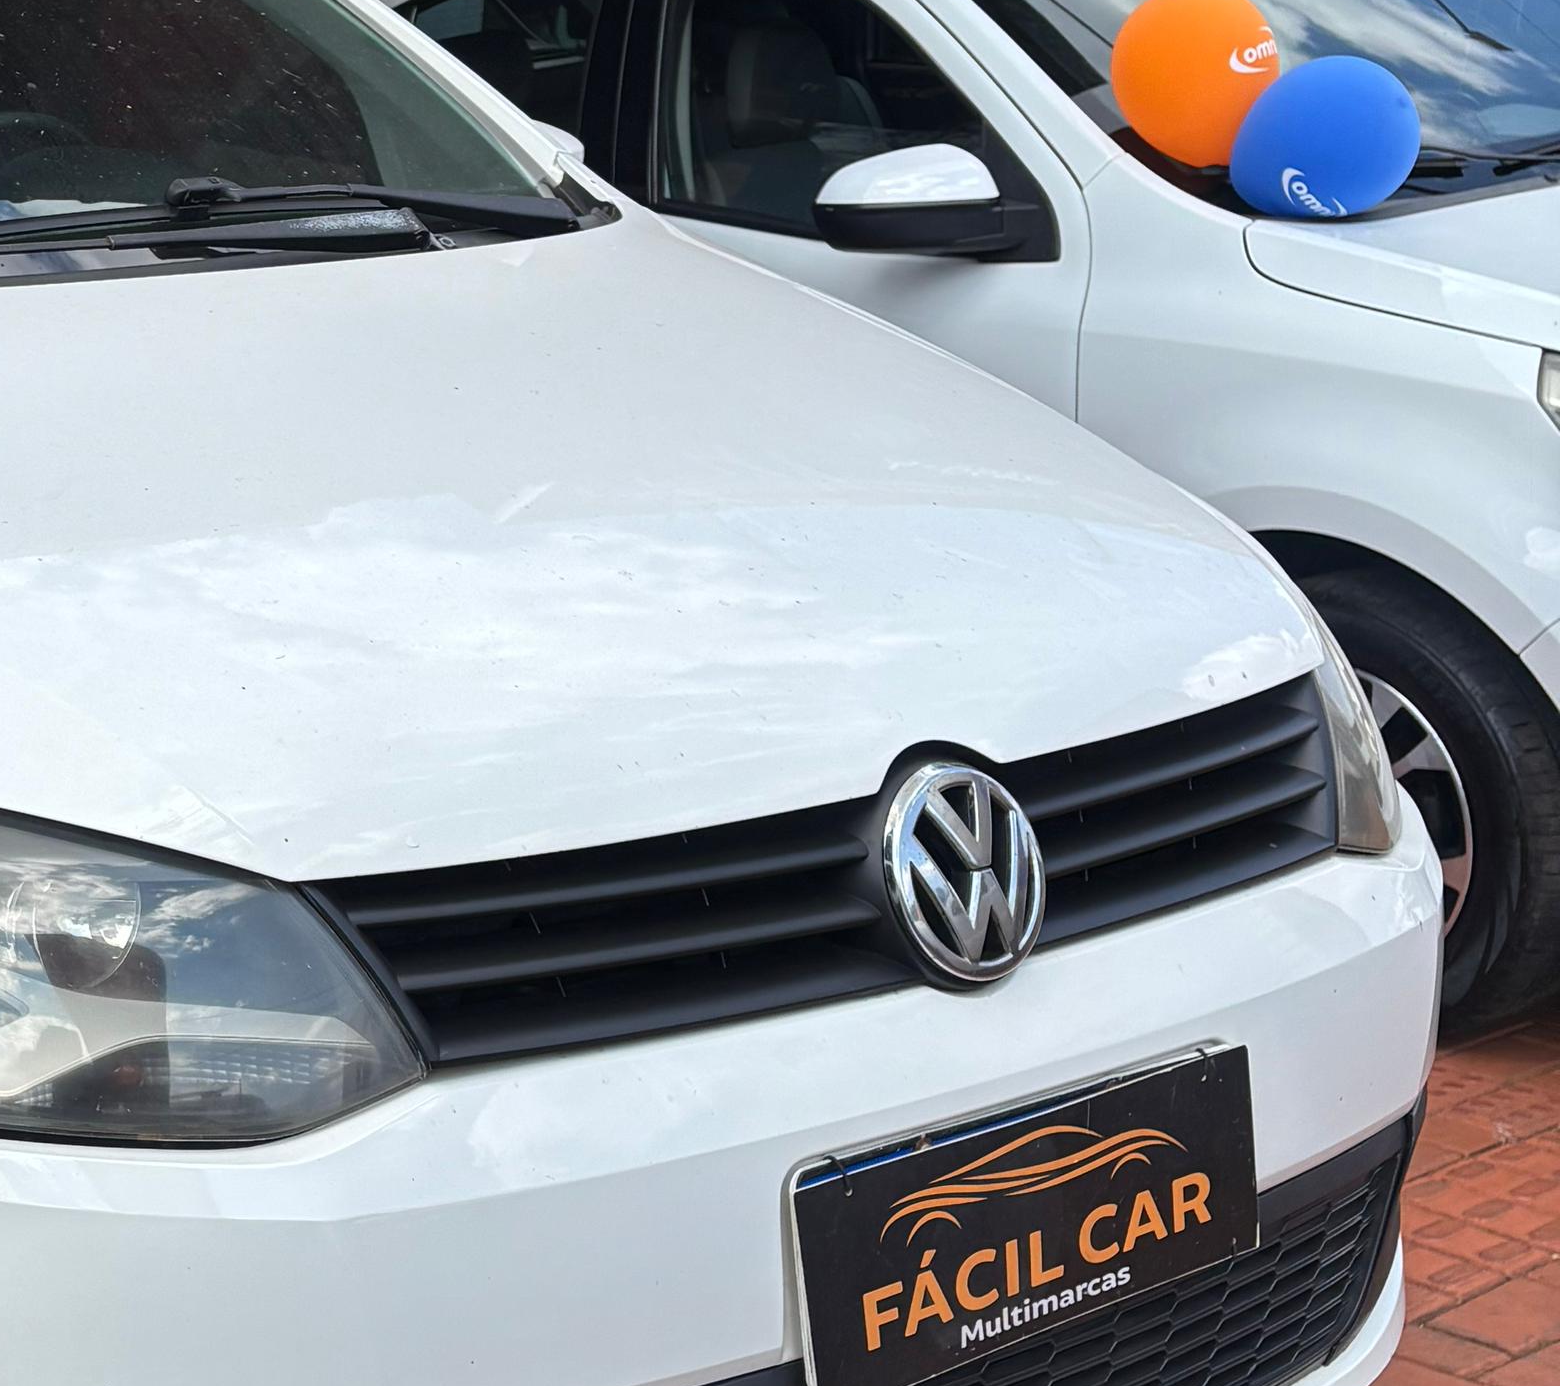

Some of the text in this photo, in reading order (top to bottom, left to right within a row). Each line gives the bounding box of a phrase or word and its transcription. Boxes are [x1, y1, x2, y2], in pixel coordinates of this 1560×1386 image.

[860, 1171, 1213, 1353] FÁCIL CAR
[959, 1264, 1133, 1349] Multimarcas
